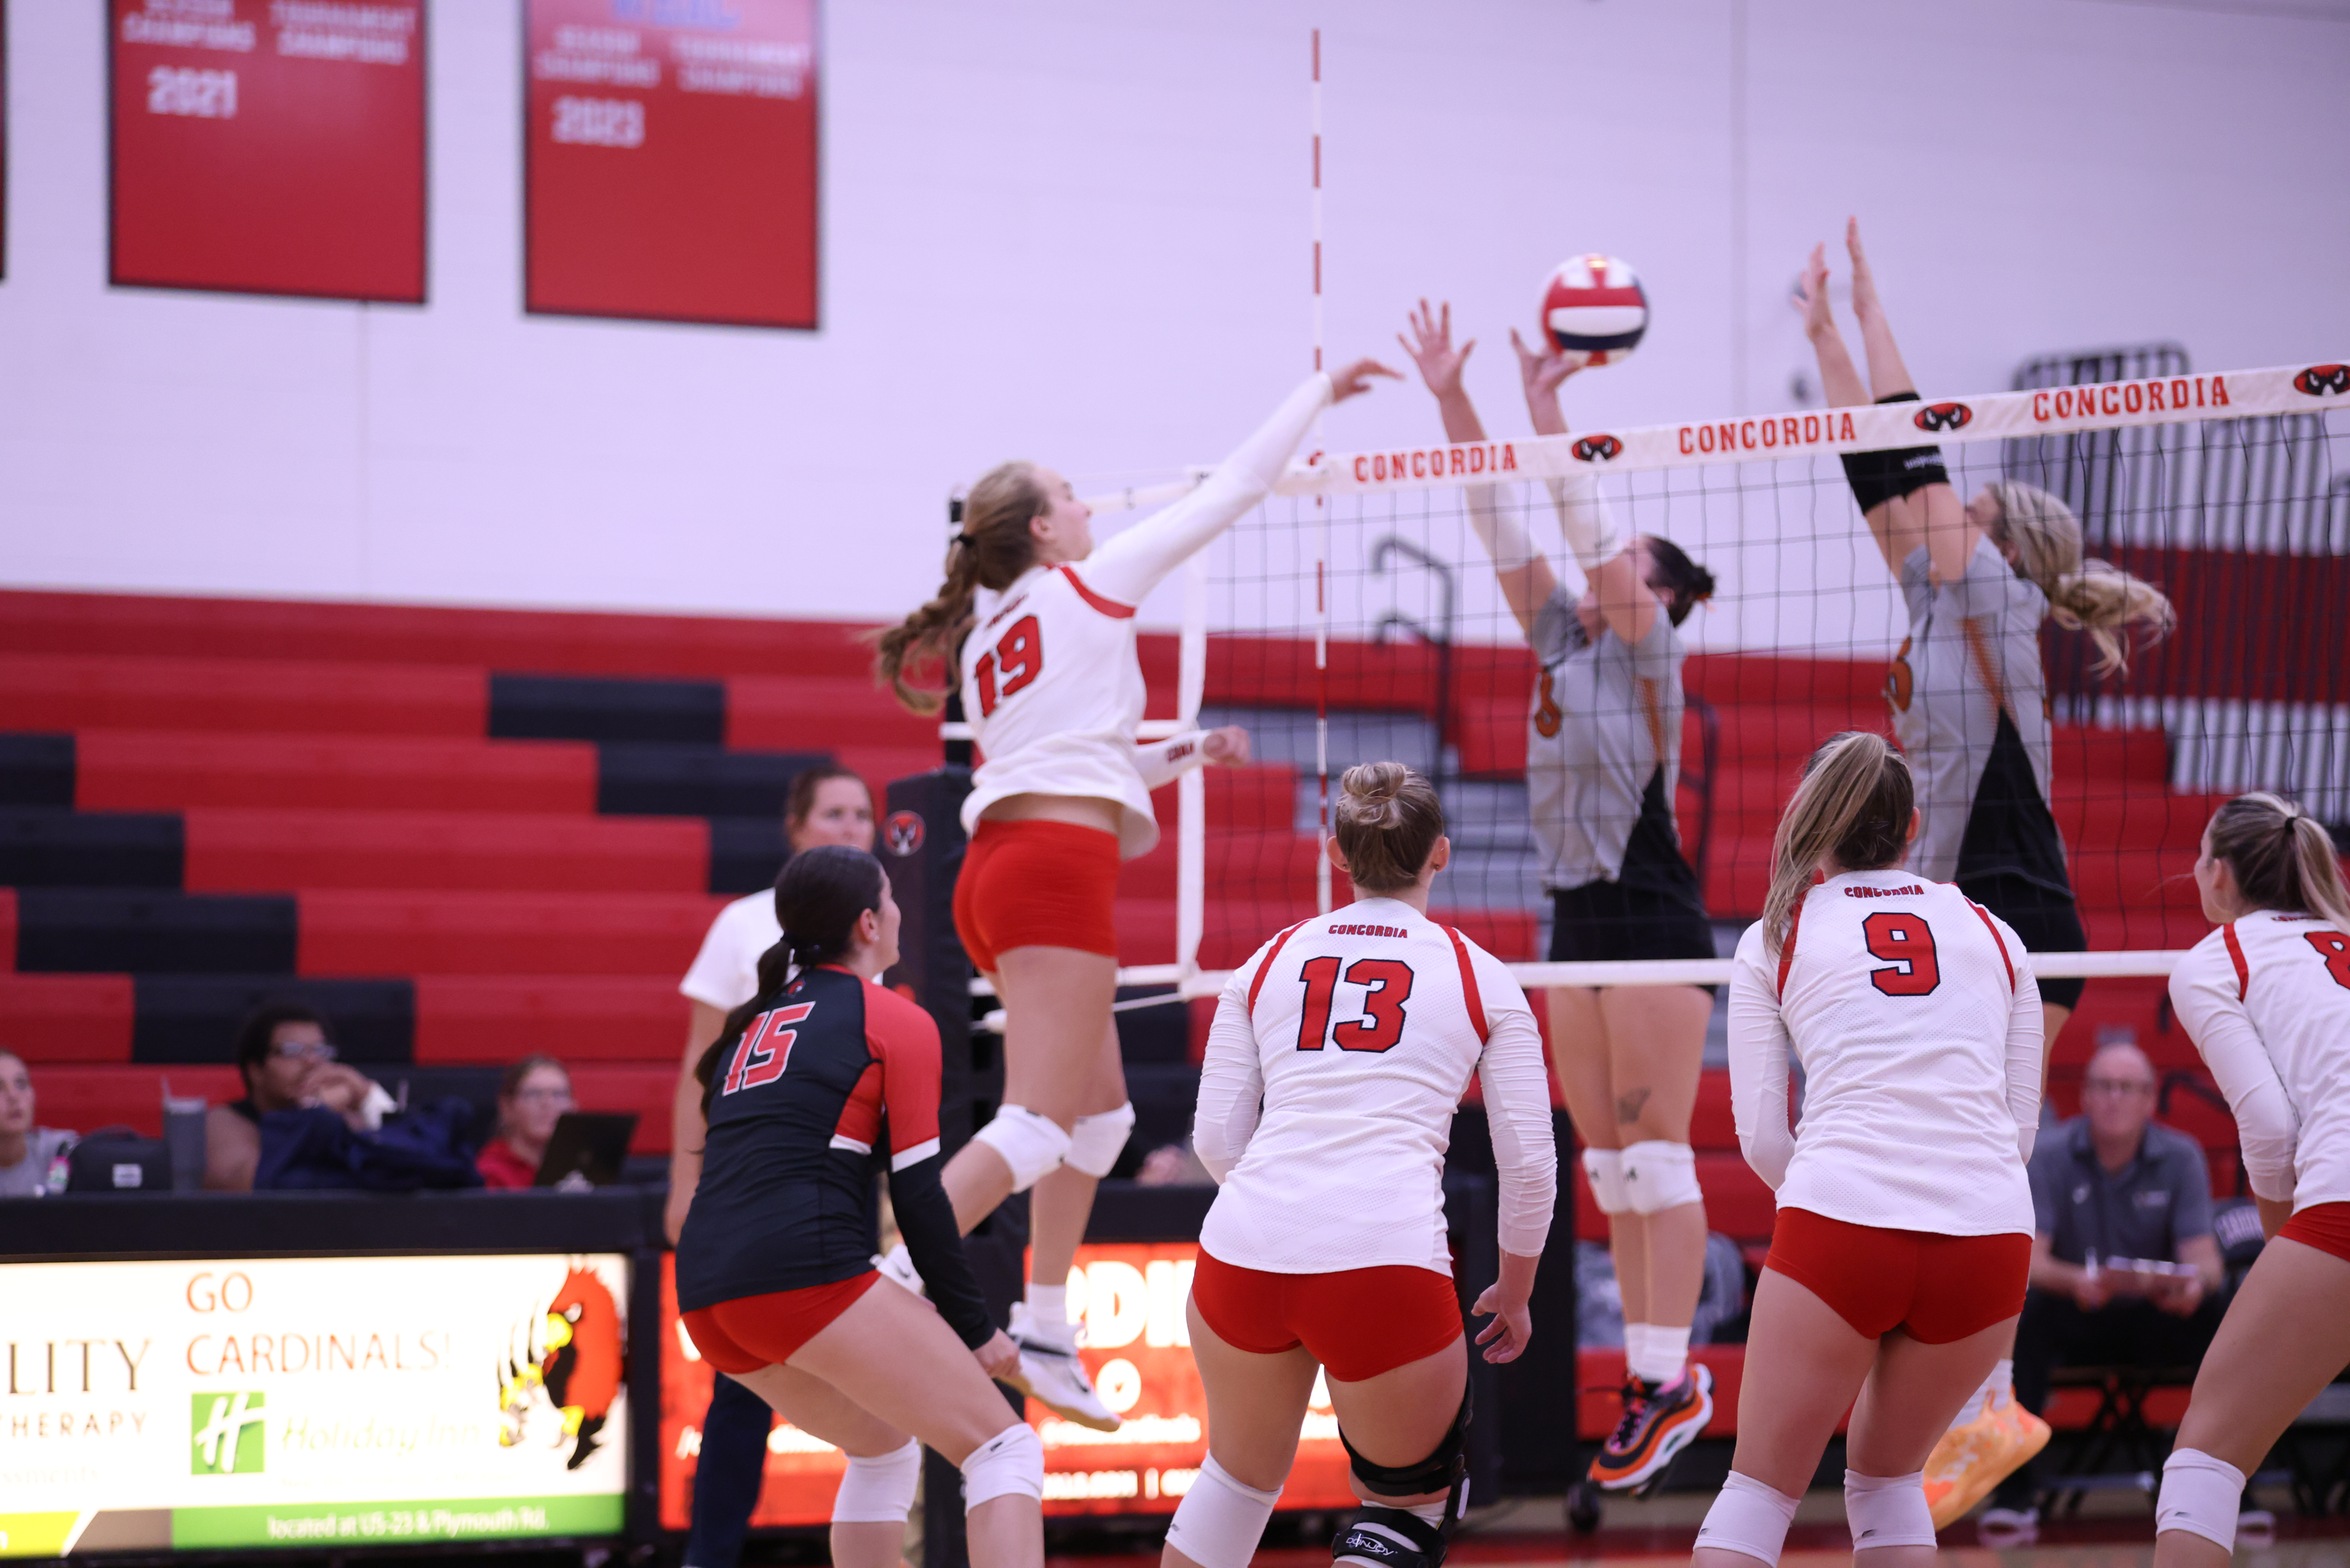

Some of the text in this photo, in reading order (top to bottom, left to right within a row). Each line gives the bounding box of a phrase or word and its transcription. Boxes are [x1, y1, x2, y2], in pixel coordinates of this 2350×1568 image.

[148, 65, 238, 119] 2021
[551, 94, 645, 148] 2023
[2033, 376, 2230, 422] CONCORDIA
[1679, 412, 1856, 455] CONCORDIA
[1355, 444, 1517, 482] CONCORDIA
[974, 615, 1043, 718] 19
[1328, 924, 1408, 938] CONCORDIA
[1862, 912, 1941, 996] 9
[1296, 955, 1414, 1053] 13
[722, 1001, 816, 1096] 15
[186, 1271, 253, 1313] GO
[186, 1329, 450, 1375] CARDINALS!
[0, 1410, 147, 1438] HERAPY
[282, 1413, 481, 1456] Holiday Inn
[267, 1514, 336, 1539] located
[339, 1516, 357, 1537] at
[360, 1511, 413, 1536] US-23
[414, 1510, 431, 1534] &
[431, 1508, 517, 1538] Plymouth
